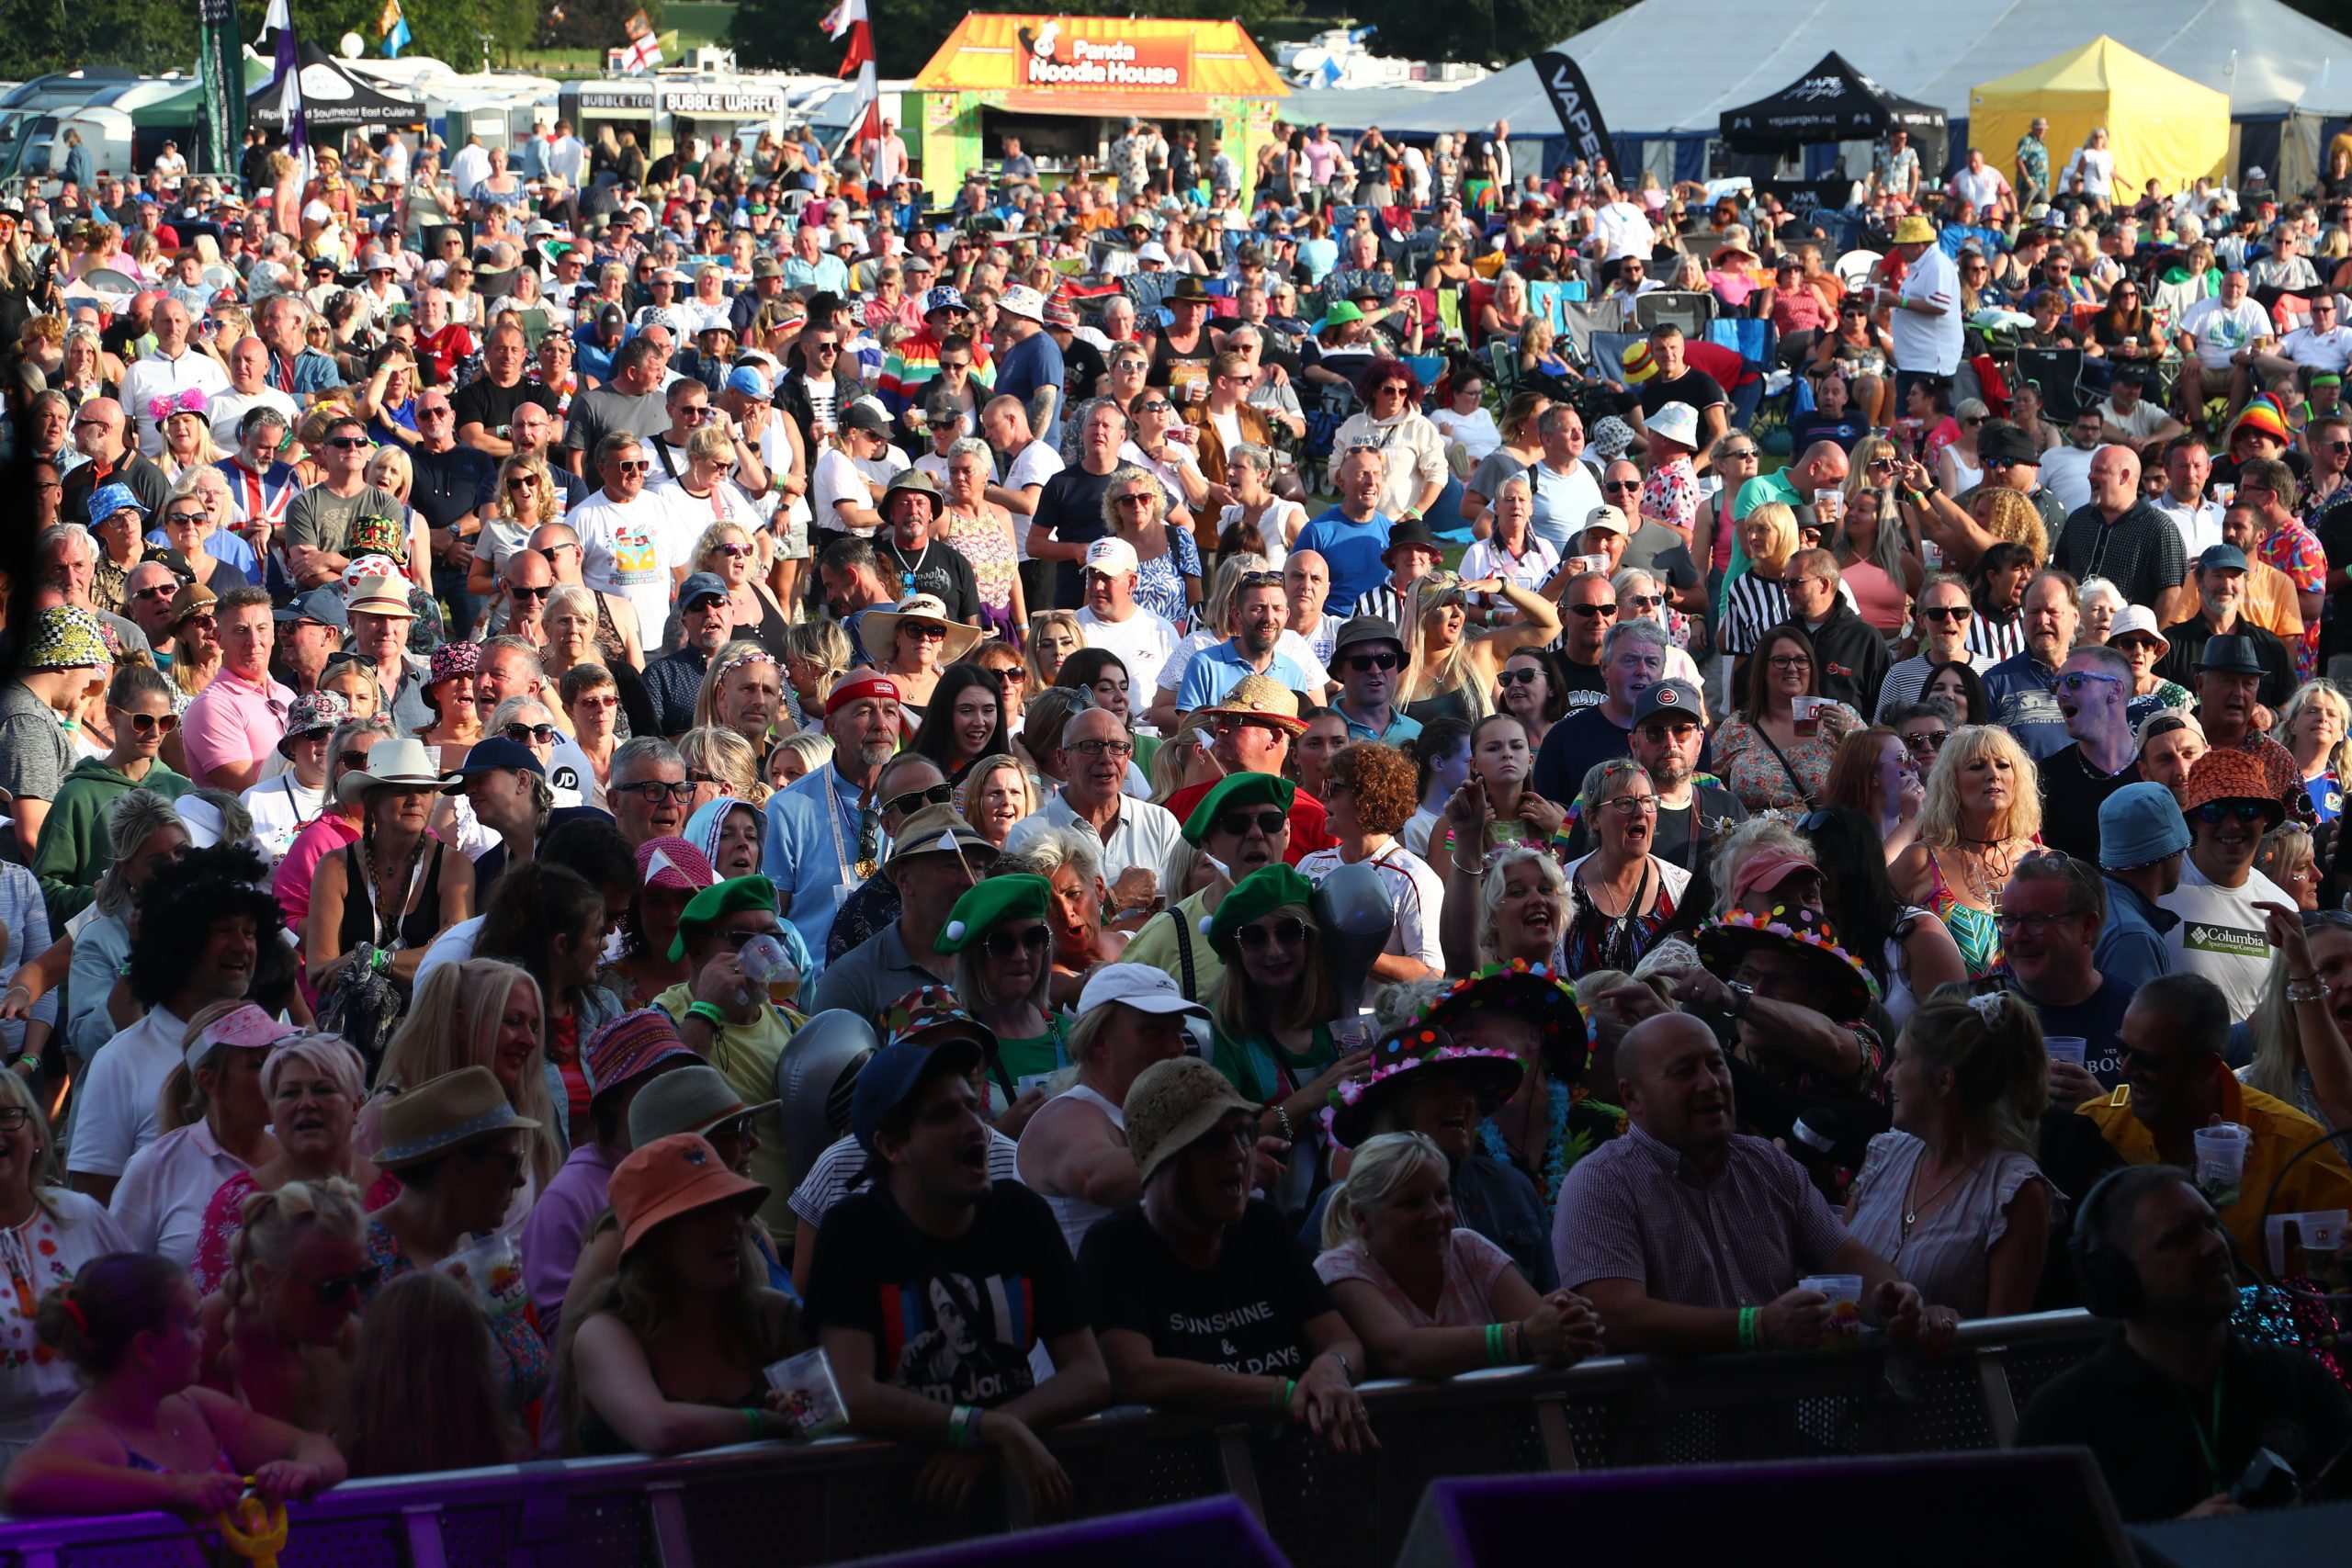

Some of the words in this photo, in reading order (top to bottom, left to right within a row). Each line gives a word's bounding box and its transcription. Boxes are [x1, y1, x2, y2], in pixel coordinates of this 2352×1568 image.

[1073, 39, 1136, 61] Panda
[1029, 59, 1106, 82] Noodle
[1107, 61, 1178, 85] House
[1805, 76, 1840, 88] VAPE
[582, 95, 626, 107] BUBBLE
[631, 95, 653, 107] TEA
[667, 94, 720, 111] BUBBLE
[724, 95, 780, 112] WAFFLE
[258, 108, 290, 120] Filipi
[313, 107, 359, 118] Southeast
[361, 107, 380, 118] East
[382, 107, 416, 118] Cuisine
[557, 773, 576, 787] JD
[2208, 928, 2264, 947] Columbia
[2208, 940, 2238, 950] Sportswear
[2239, 943, 2264, 954] Company
[2086, 1057, 2122, 1074] BOS
[1170, 1301, 1274, 1334] SUNSHINE
[1221, 1338, 1238, 1355] &
[1247, 1346, 1300, 1375] DAYS
